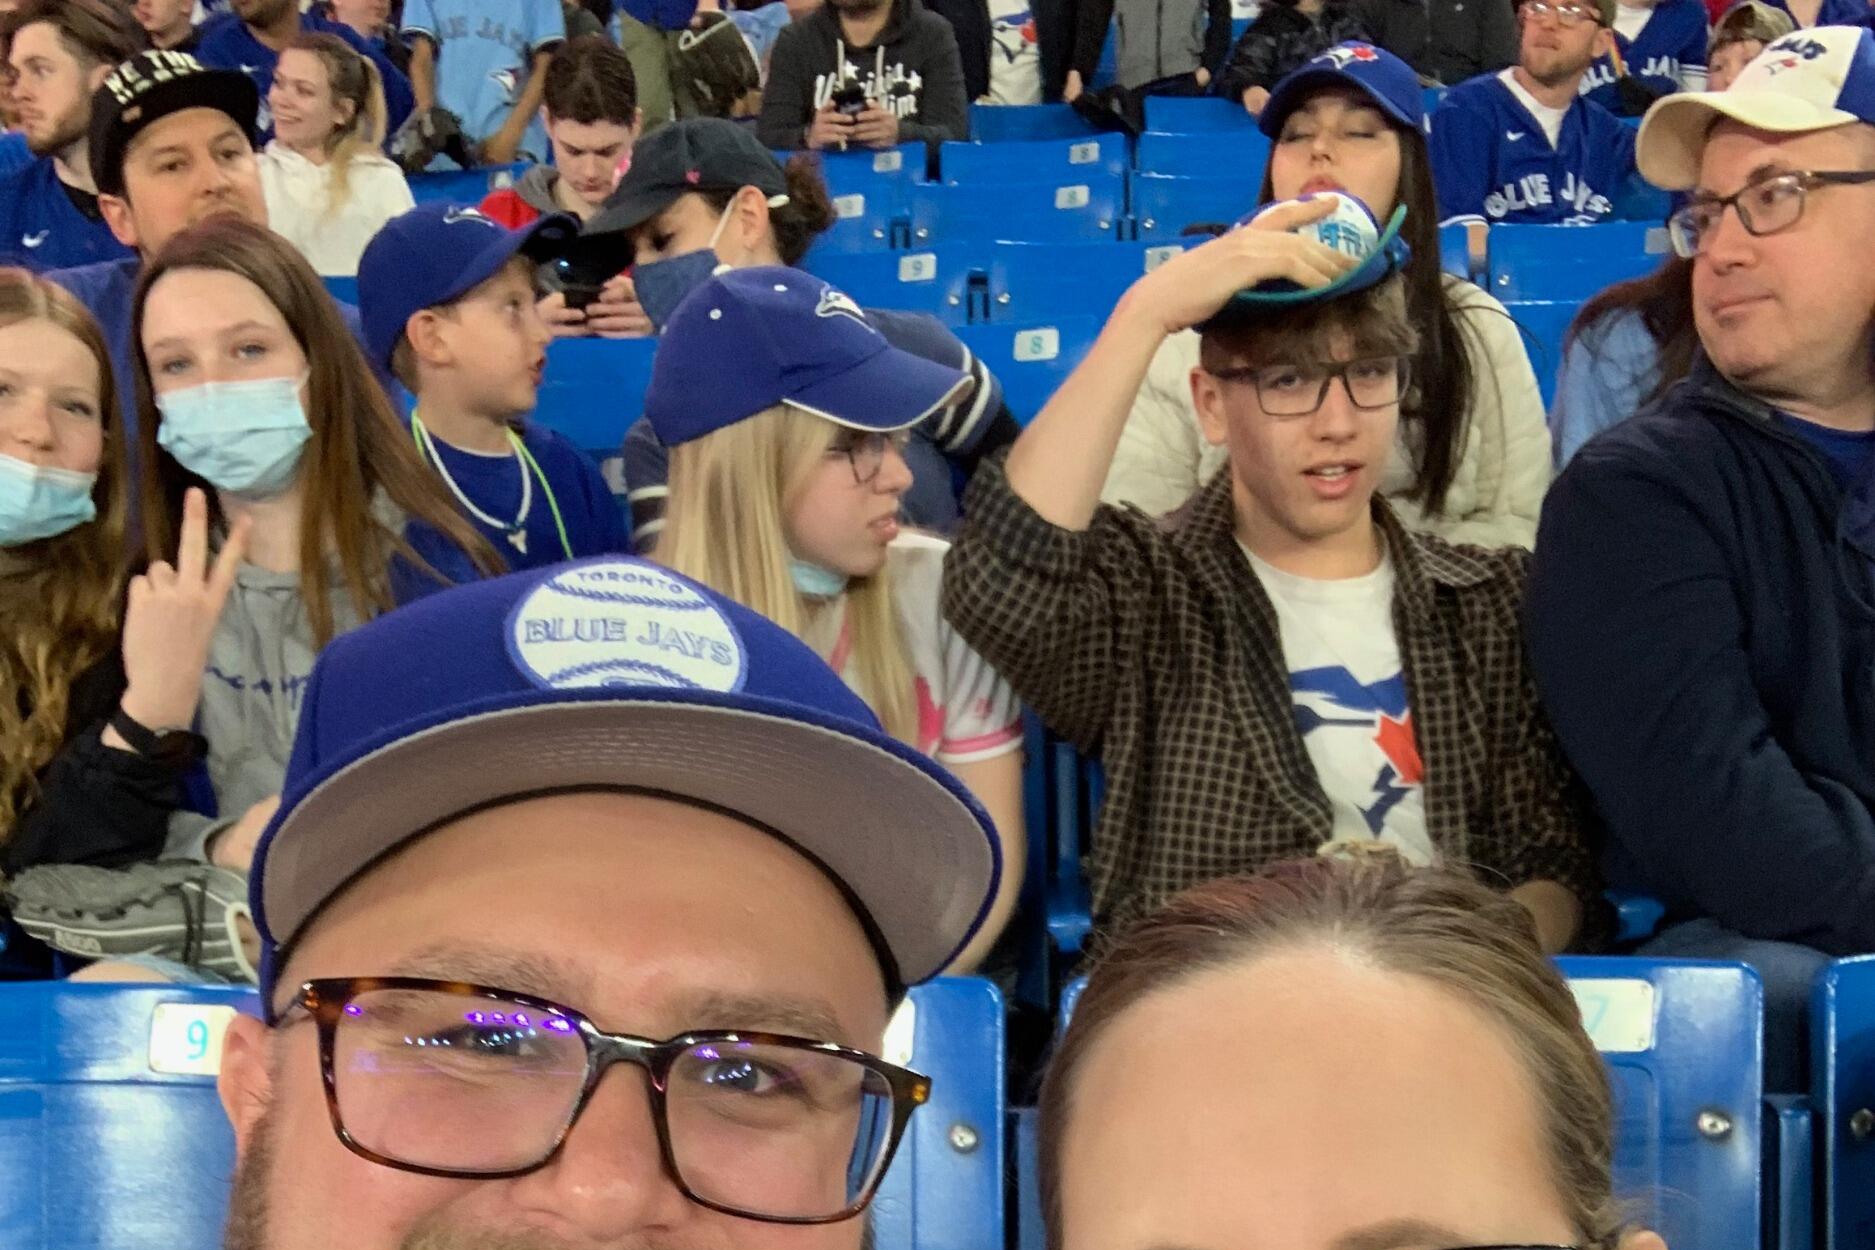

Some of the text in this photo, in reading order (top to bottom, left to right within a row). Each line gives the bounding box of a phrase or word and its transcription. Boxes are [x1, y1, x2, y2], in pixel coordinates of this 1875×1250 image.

[1483, 173, 1553, 219] BLUE
[911, 260, 923, 277] 9
[1030, 335, 1044, 354] 8
[577, 571, 684, 594] TORONTO
[524, 617, 733, 666] BLUE JAYS
[1585, 994, 1610, 1032] 7
[186, 1019, 209, 1060] 9
